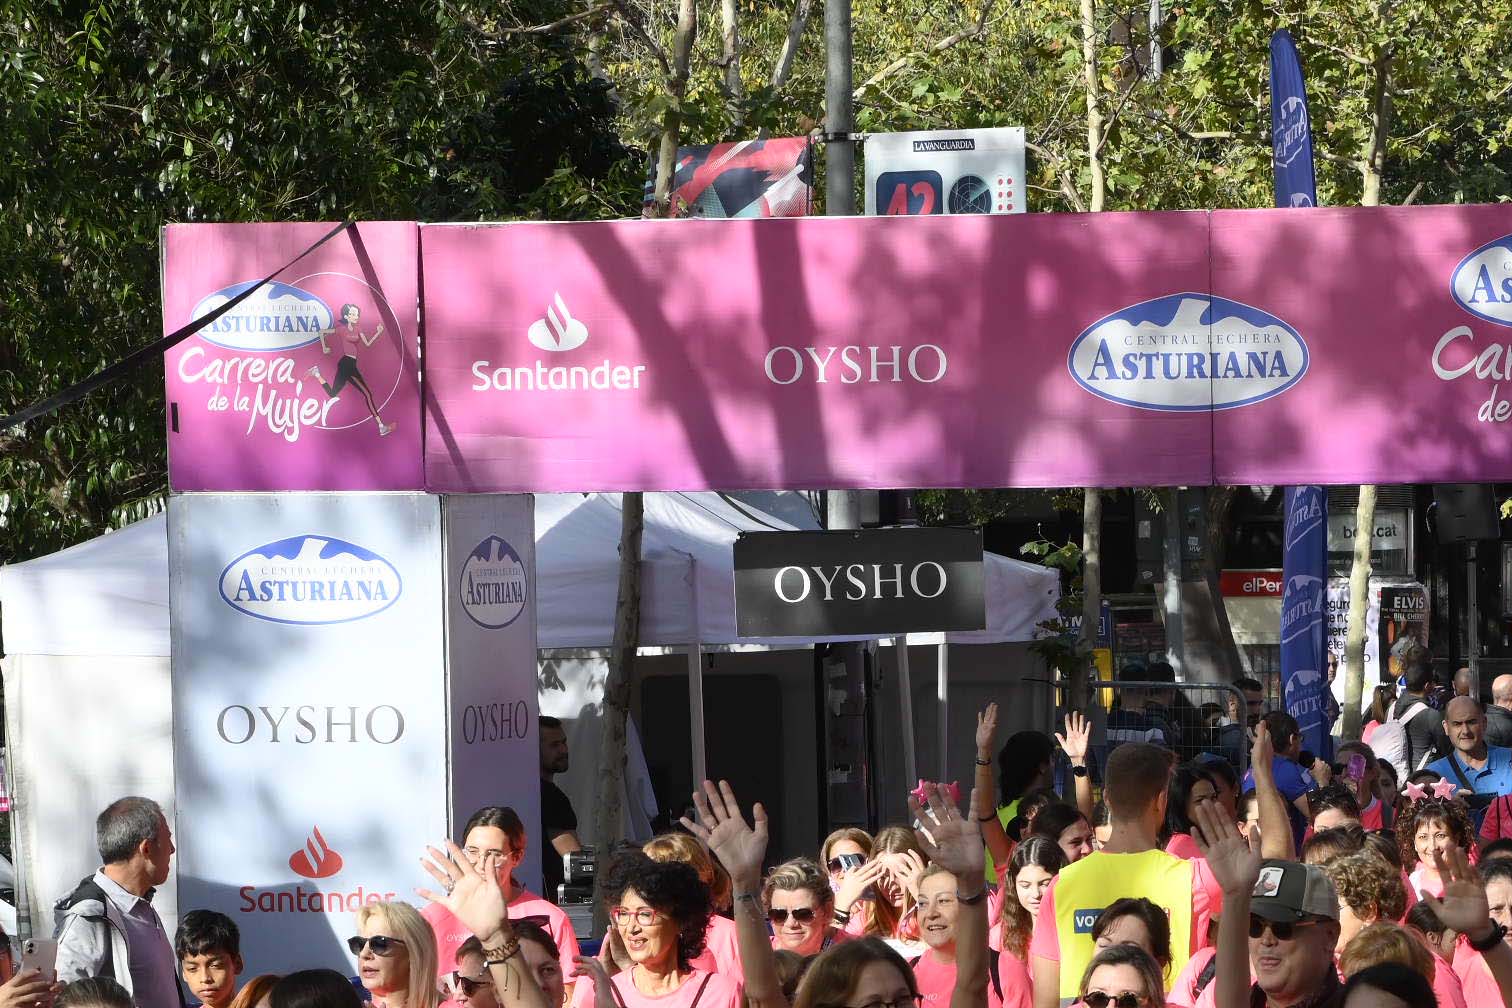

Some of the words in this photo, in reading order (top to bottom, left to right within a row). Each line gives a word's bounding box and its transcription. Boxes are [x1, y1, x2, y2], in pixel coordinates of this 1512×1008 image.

[204, 306, 321, 333] ASTURIANA
[1124, 334, 1199, 345] CENTRAL
[1207, 332, 1281, 344] LECHERA
[178, 346, 295, 384] Carrera
[472, 360, 645, 391] Santander
[764, 344, 947, 385] OYSHO
[1087, 337, 1290, 380] ASTURIANA
[207, 386, 229, 411] de
[234, 385, 250, 412] la
[247, 380, 340, 442] Mujer
[1478, 383, 1512, 422] de
[233, 568, 390, 603] ASTURIANA
[465, 571, 523, 606] ASTURIANA
[774, 560, 948, 603] OYSHO
[1393, 597, 1424, 608] ELVIS
[217, 704, 405, 744] OYSHO
[463, 700, 528, 744] OYSHO
[240, 886, 395, 913] Santander
